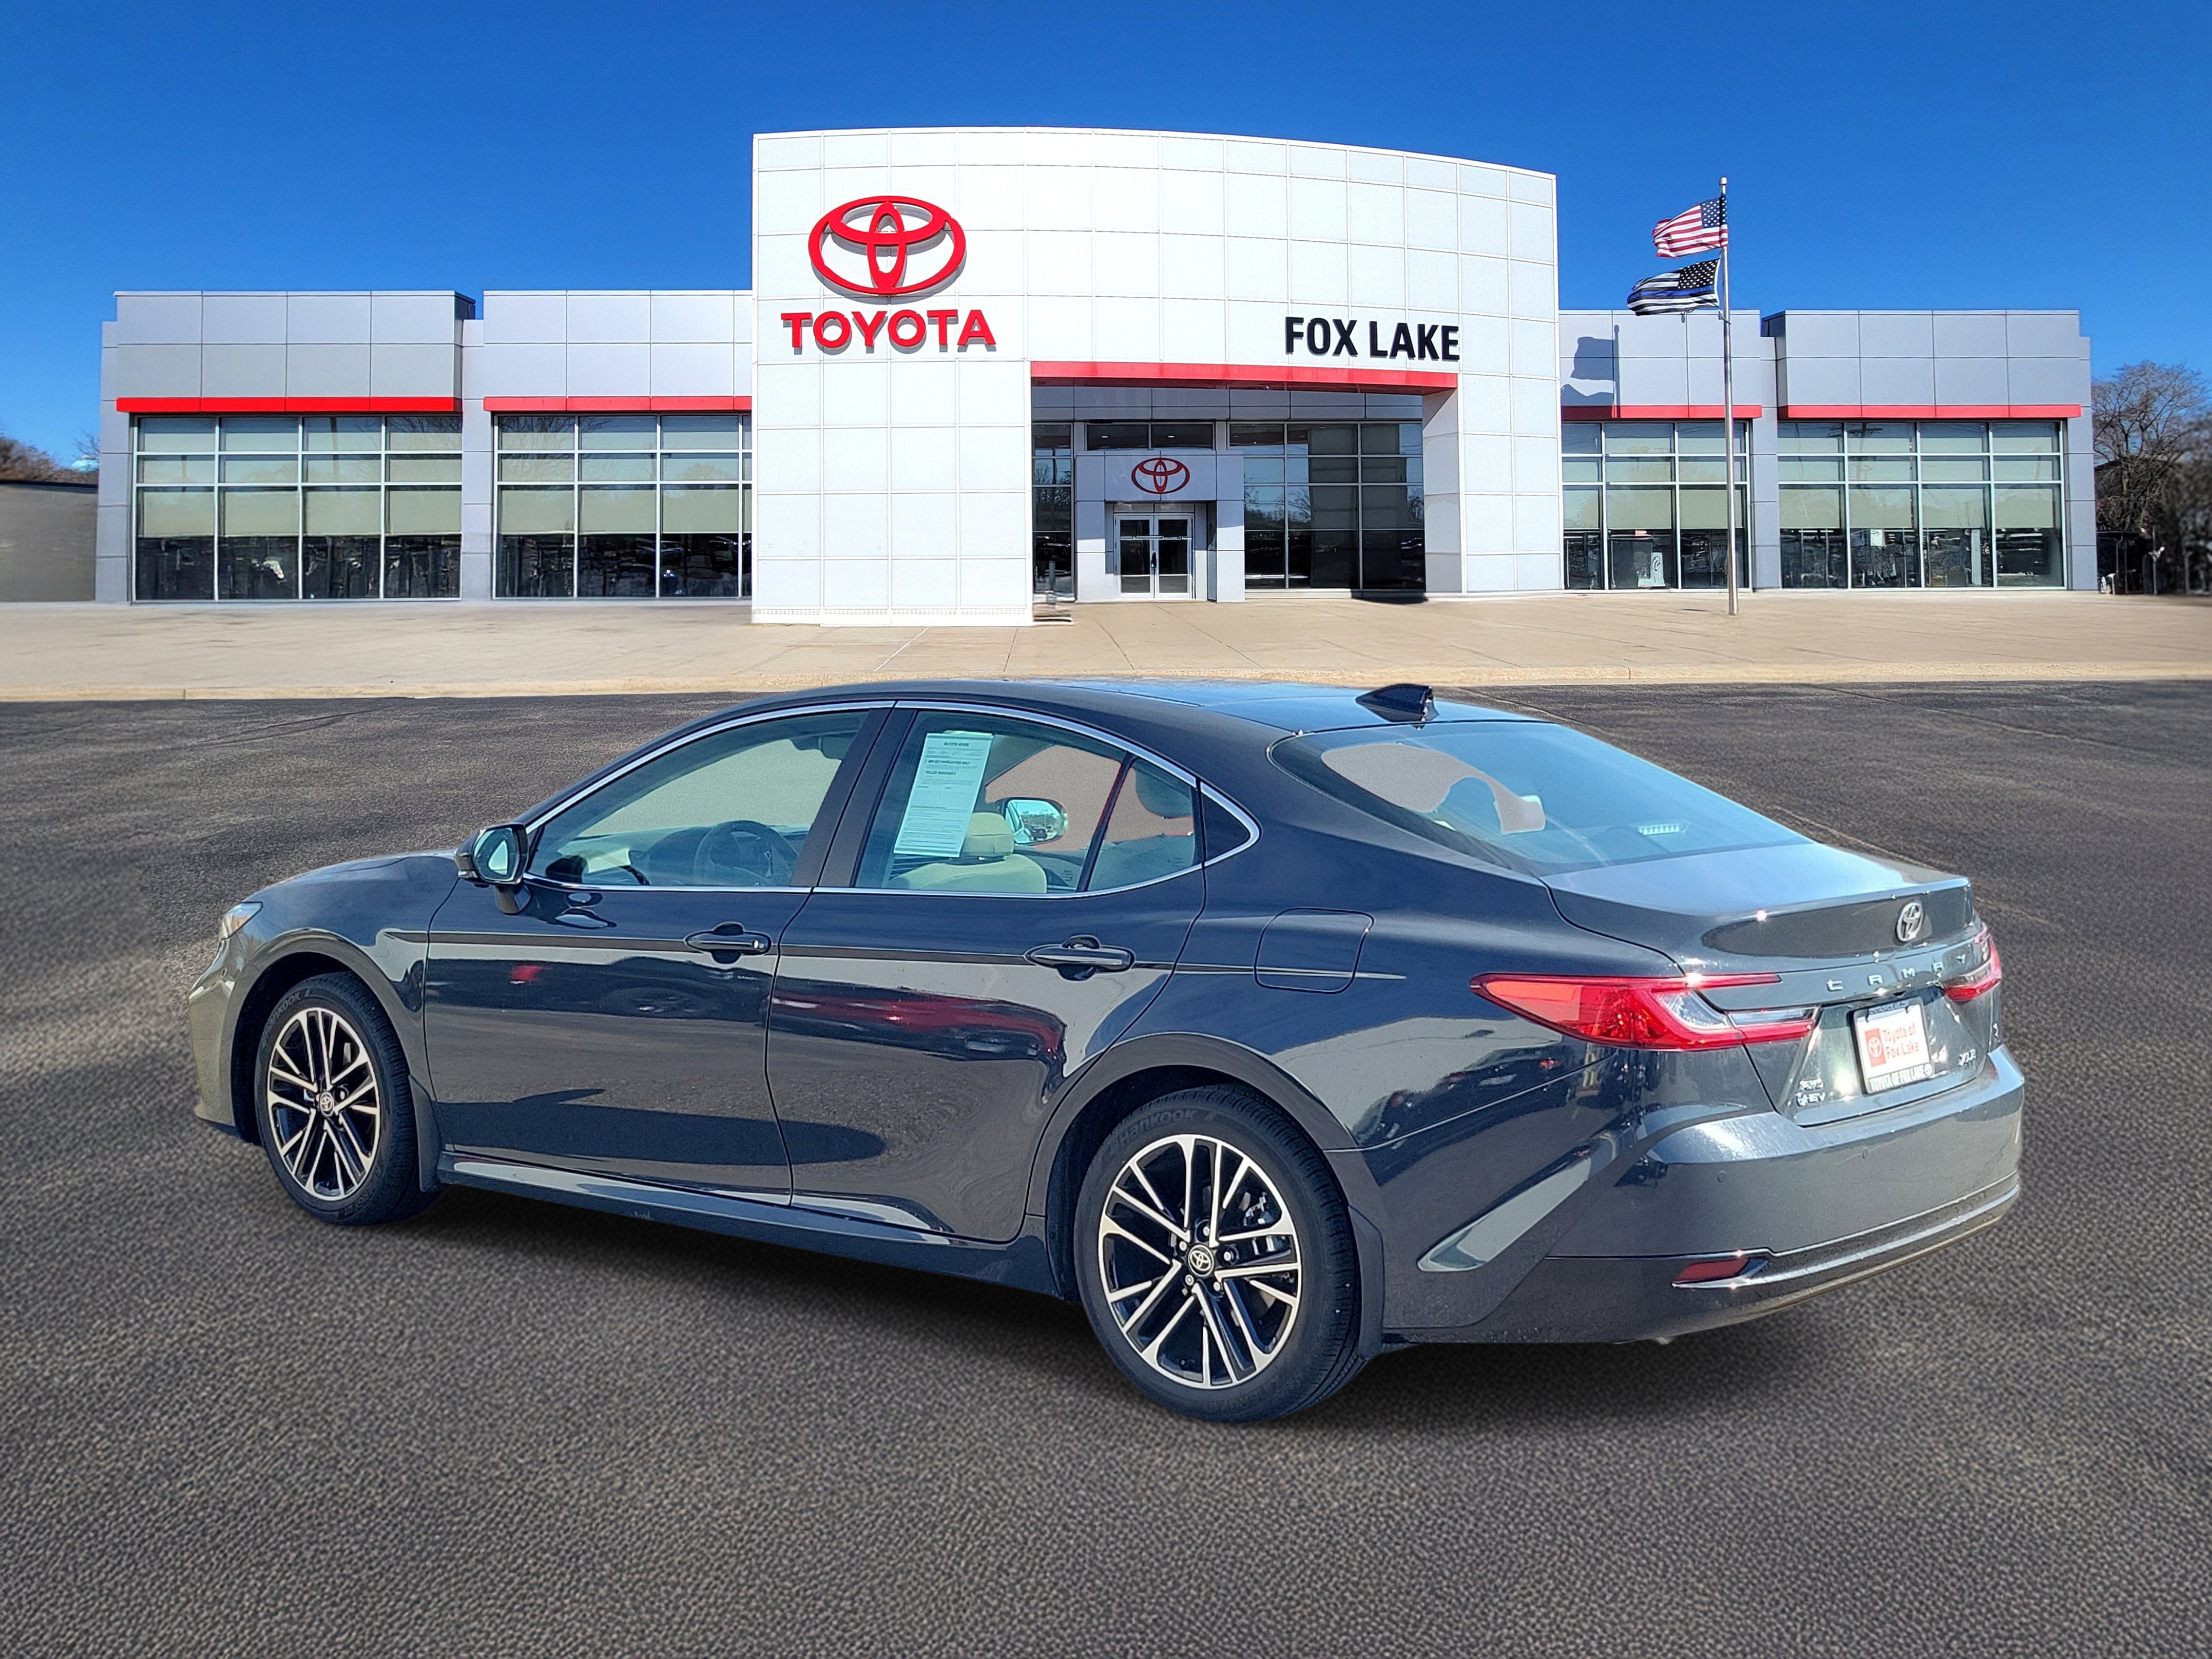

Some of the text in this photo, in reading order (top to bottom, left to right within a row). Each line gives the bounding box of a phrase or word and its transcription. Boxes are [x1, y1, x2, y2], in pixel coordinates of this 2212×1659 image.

[781, 309, 997, 349] TOYOTA
[1285, 317, 1460, 360] FOX LAKE
[1827, 954, 1966, 991] CAMRY
[1883, 1022, 1916, 1043] Toyota of
[1886, 1041, 1920, 1059] Fox Lake
